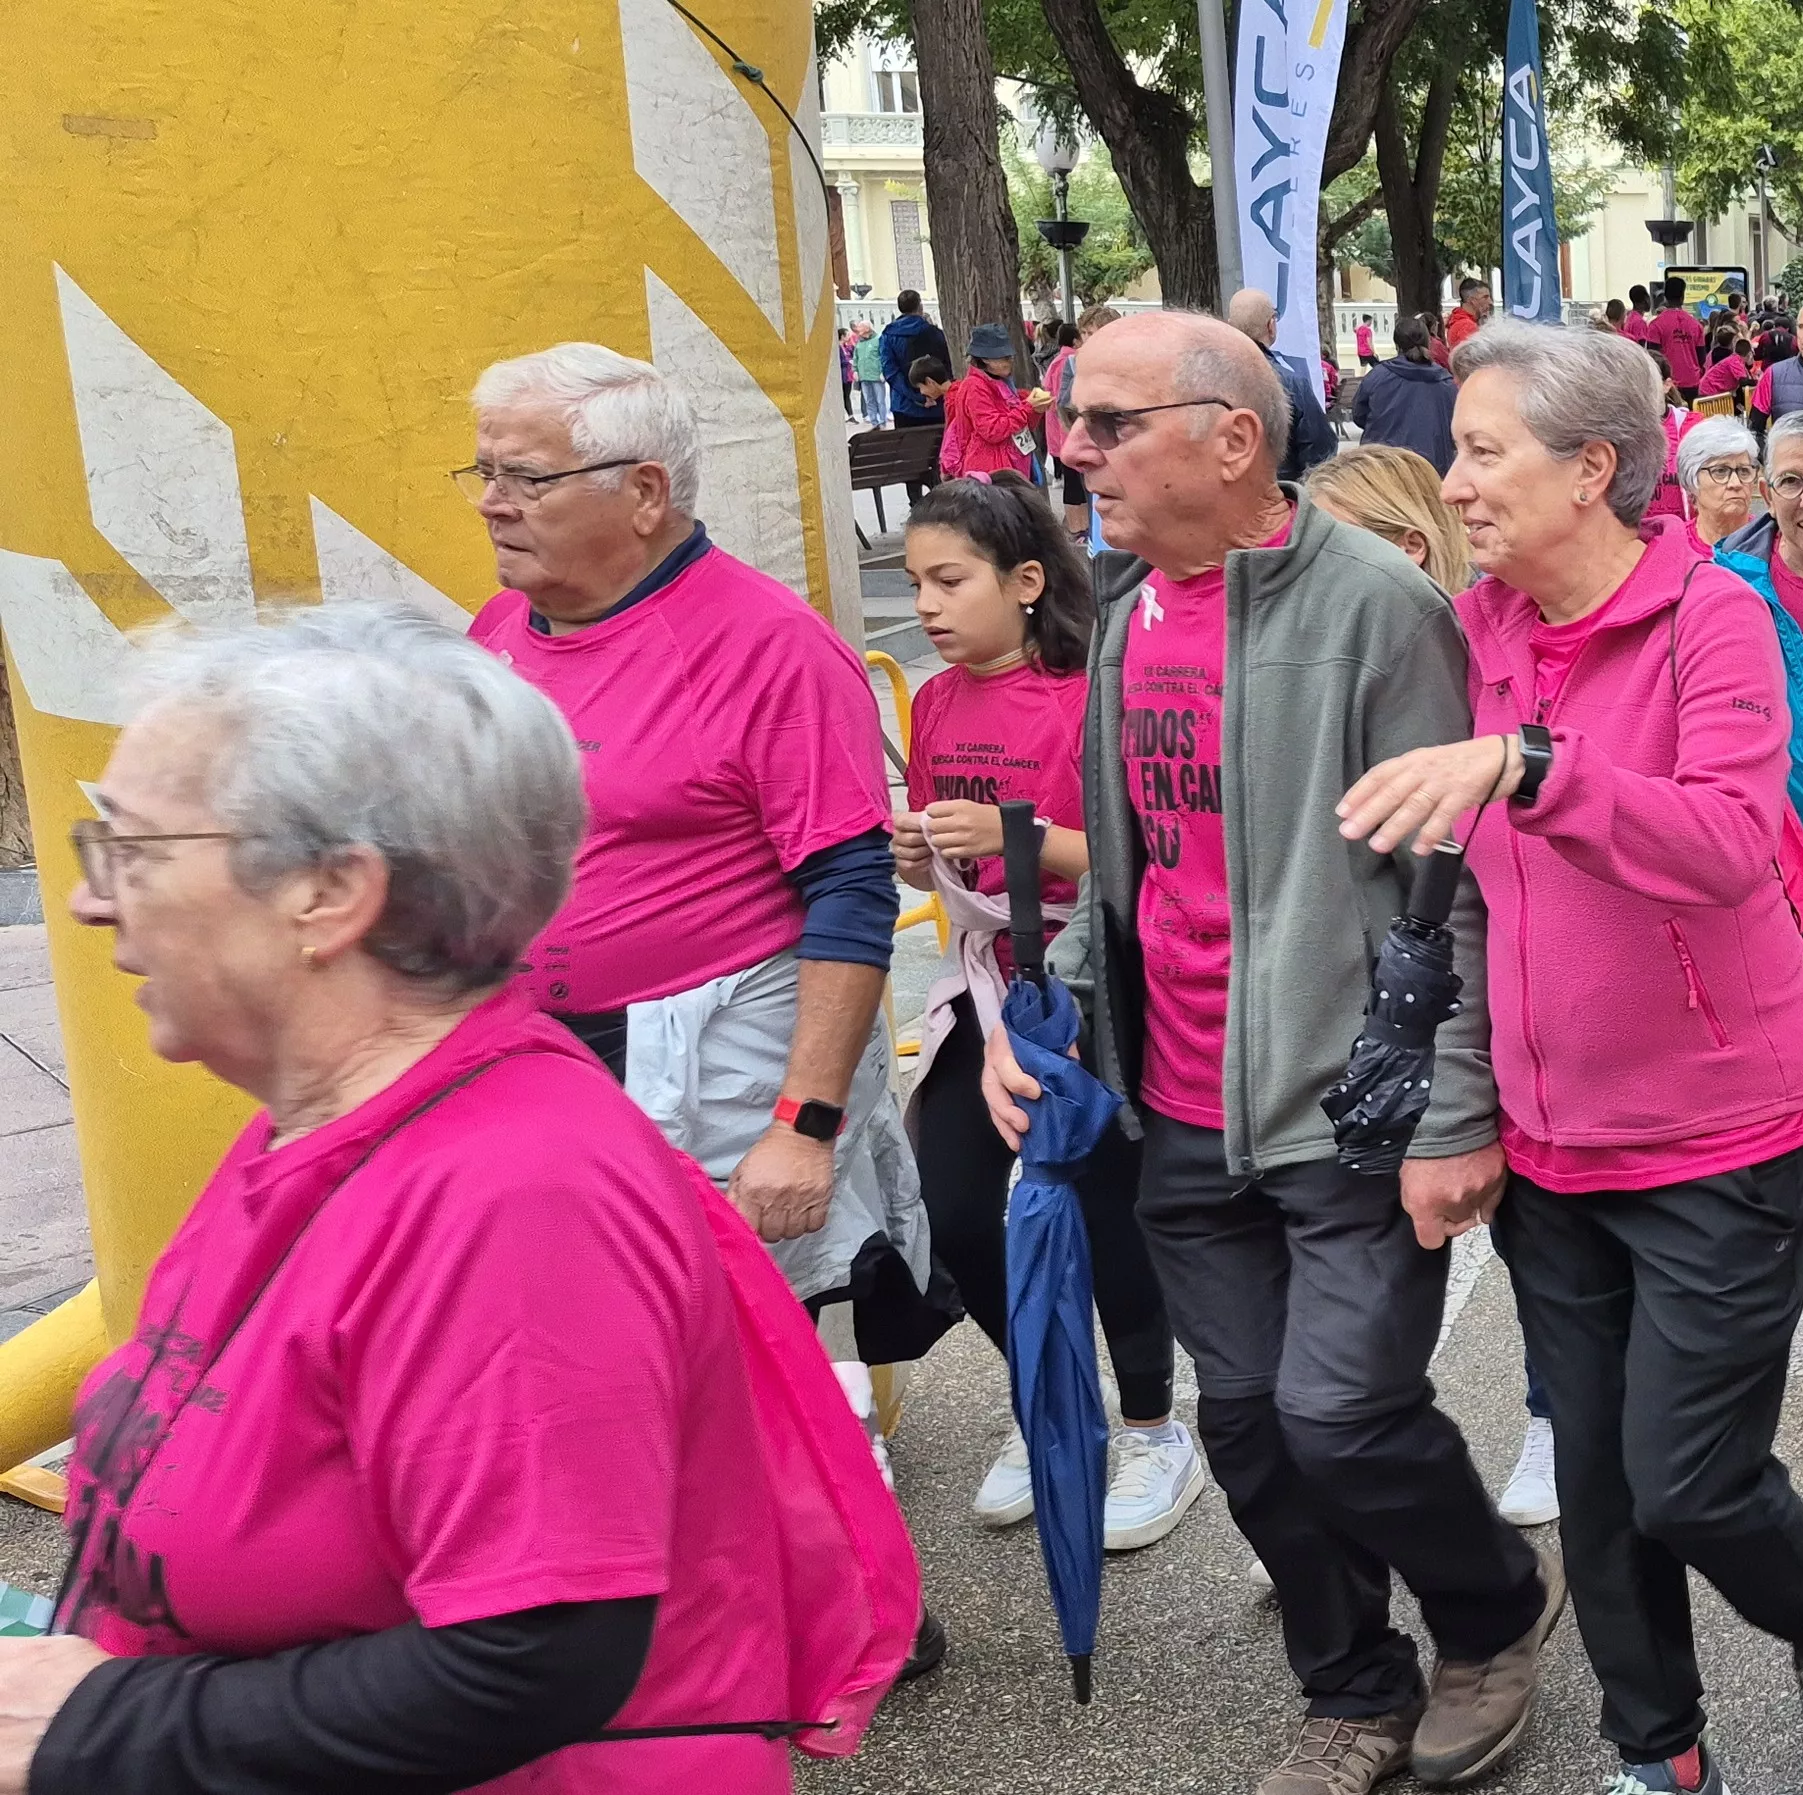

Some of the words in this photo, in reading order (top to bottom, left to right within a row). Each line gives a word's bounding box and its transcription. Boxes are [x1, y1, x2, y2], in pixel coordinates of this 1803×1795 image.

[1508, 63, 1543, 320] LAYCA
[966, 743, 1006, 755] CARRERA
[1141, 761, 1177, 812] EN
